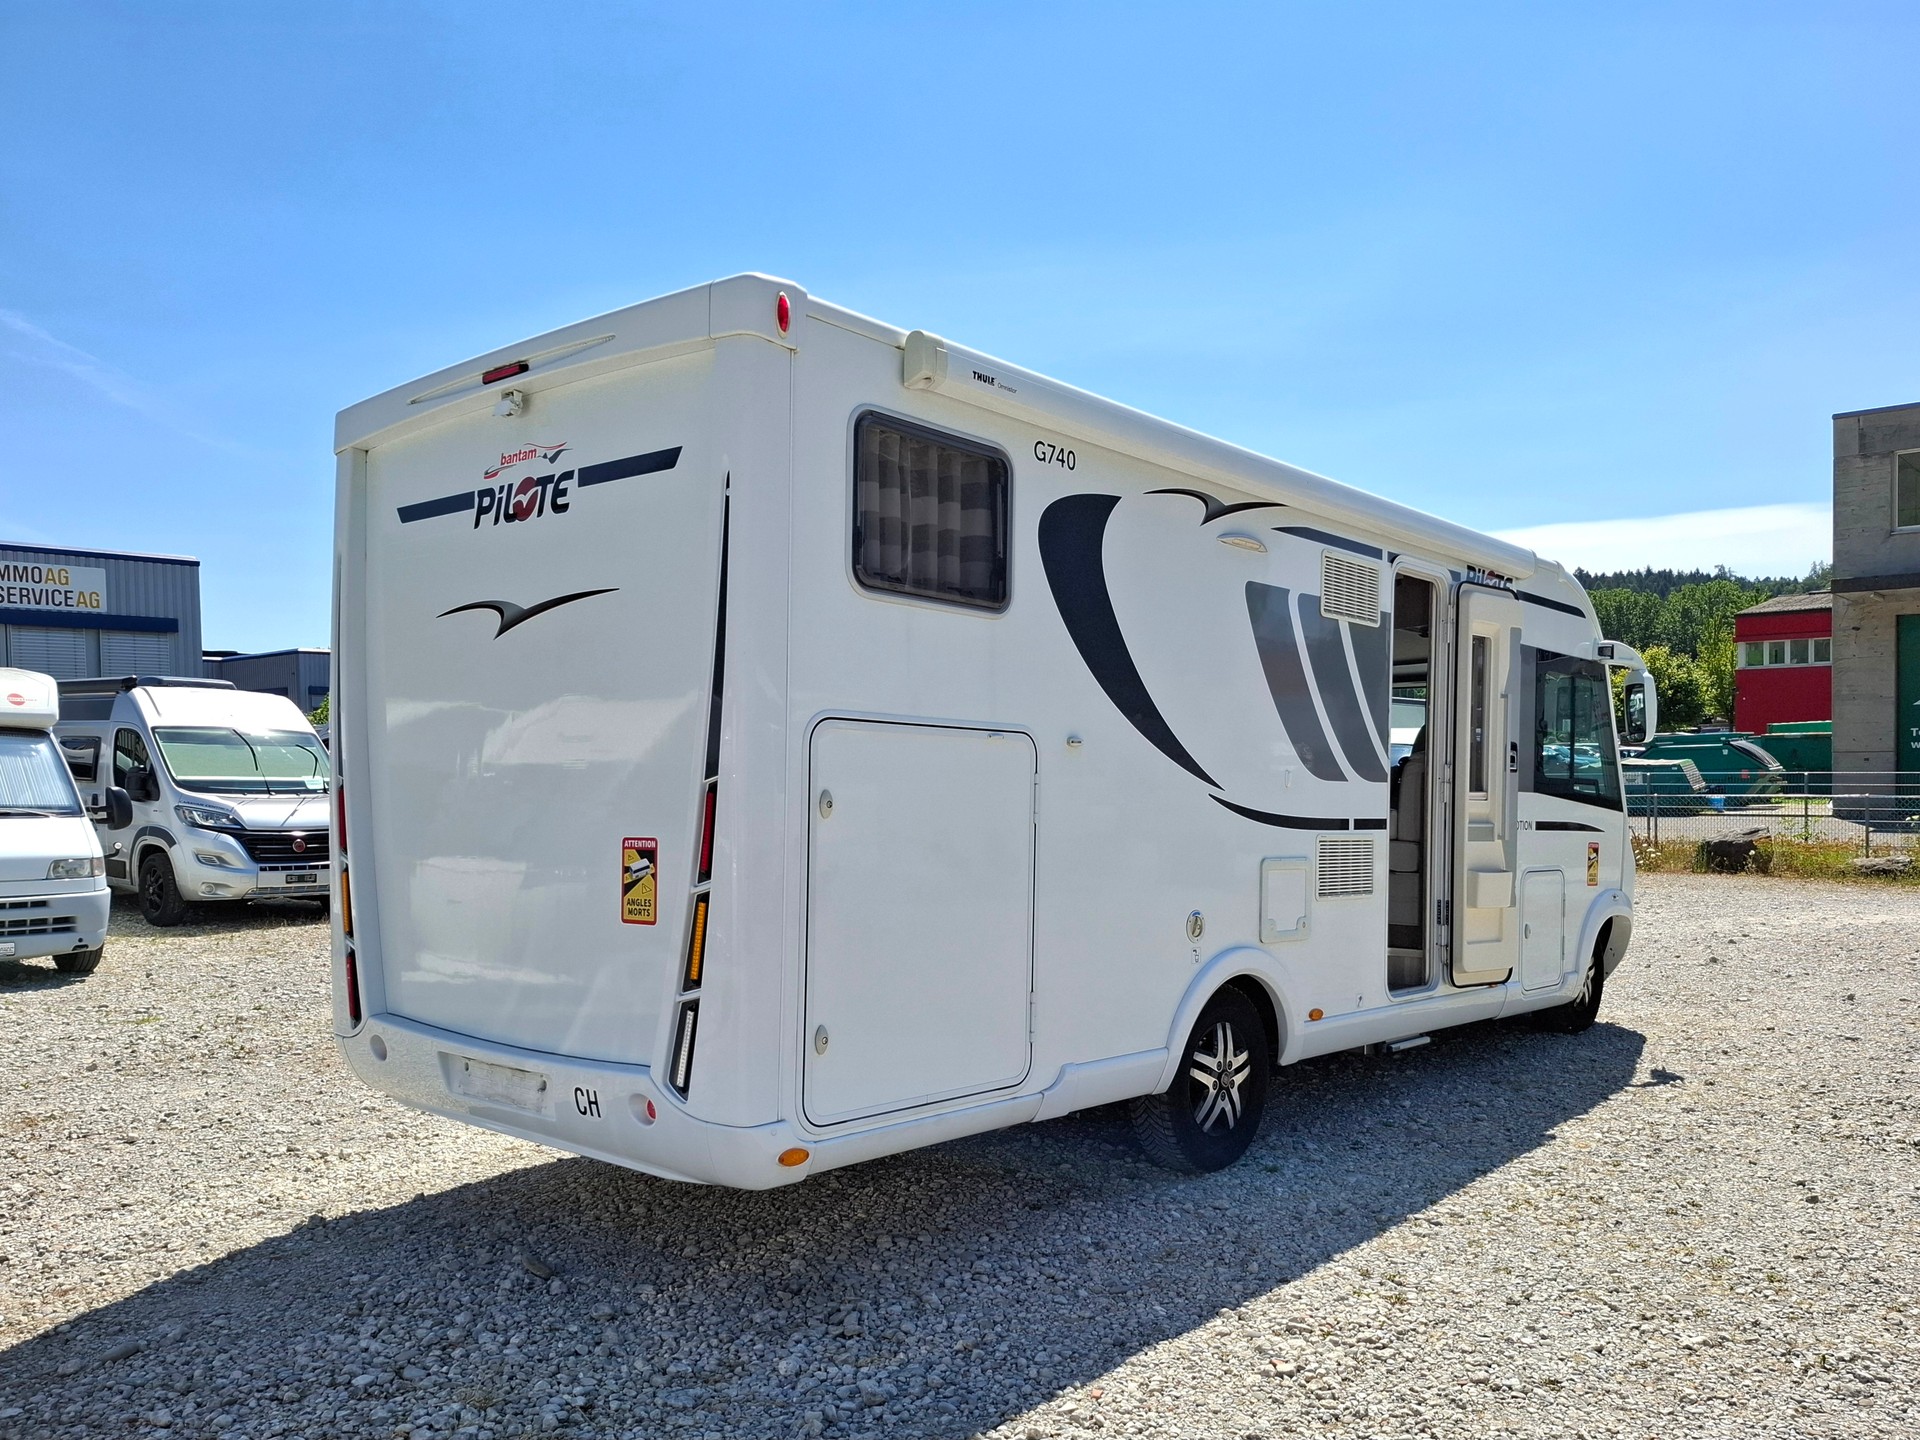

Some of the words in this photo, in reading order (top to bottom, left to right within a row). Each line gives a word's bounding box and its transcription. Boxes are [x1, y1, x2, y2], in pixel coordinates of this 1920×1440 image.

[972, 370, 996, 387] THULE
[500, 448, 537, 466] bantam
[1033, 440, 1076, 471] G740
[624, 840, 656, 848] ATTENTION
[626, 897, 652, 908] ANGLES
[627, 907, 651, 917] MORTS
[574, 1086, 602, 1119] CH
